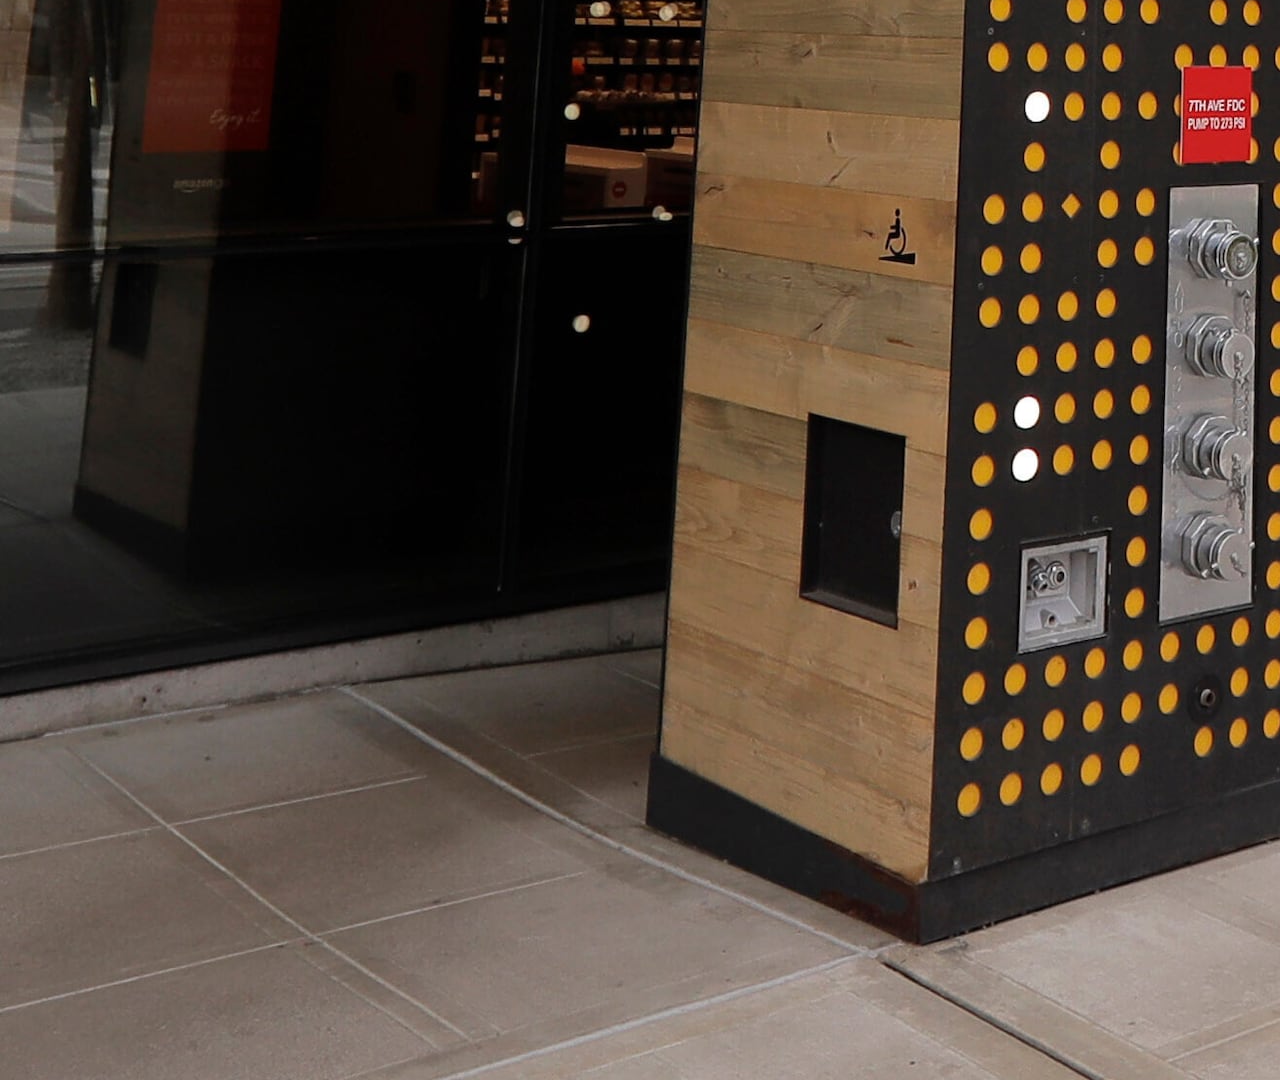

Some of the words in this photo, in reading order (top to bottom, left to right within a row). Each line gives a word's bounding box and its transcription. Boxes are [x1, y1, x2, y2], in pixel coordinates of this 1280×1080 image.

[1188, 99, 1206, 112] 7TH
[1207, 99, 1225, 112] AVE
[1226, 99, 1246, 111] FDC
[1188, 117, 1209, 130] PUMP
[1210, 117, 1220, 129] TO
[1220, 117, 1234, 129] 273
[1233, 117, 1246, 129] PSI
